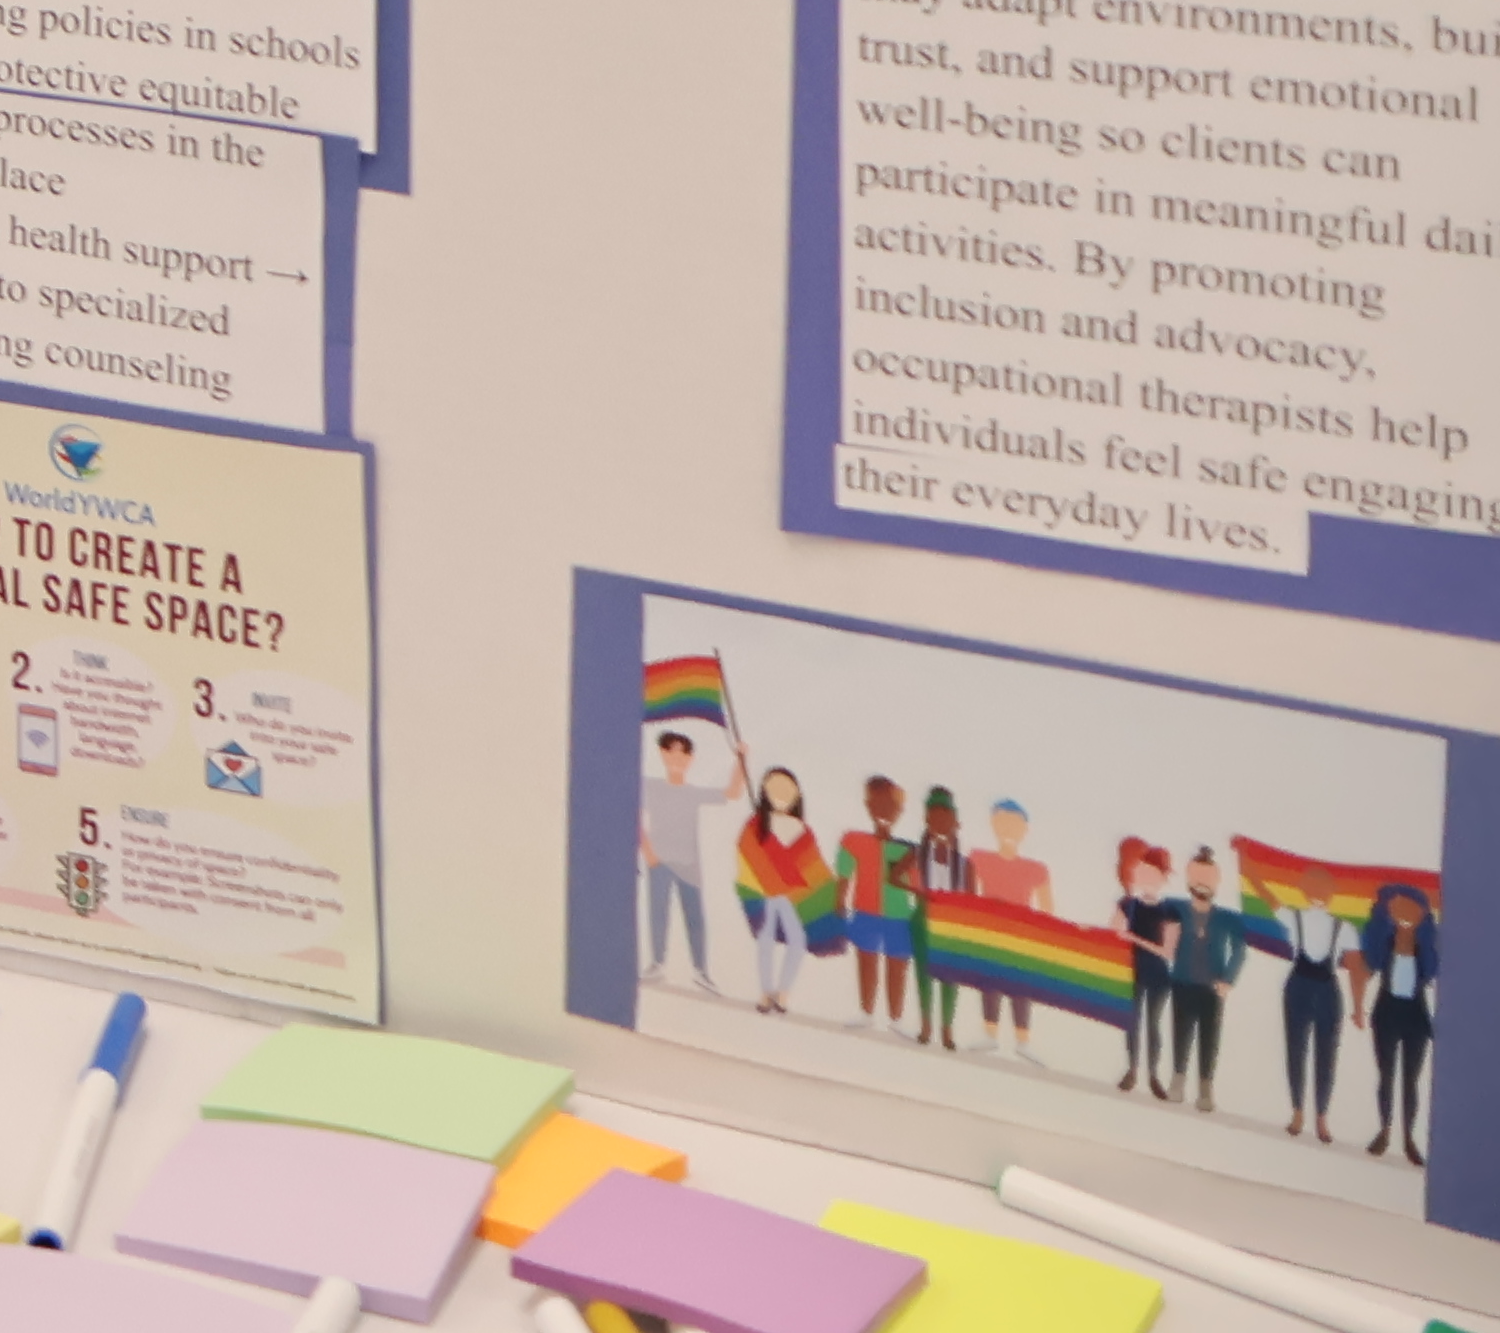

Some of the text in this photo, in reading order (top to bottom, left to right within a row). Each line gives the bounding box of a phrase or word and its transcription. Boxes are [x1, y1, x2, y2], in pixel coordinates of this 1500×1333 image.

[3, 479, 157, 527] WorldYWCA
[12, 516, 56, 563] TO
[67, 526, 207, 590] CREATE
[219, 552, 246, 595] A
[41, 574, 132, 627] SAFE
[142, 591, 287, 653] SPACE?
[11, 650, 44, 695] 2.
[192, 677, 229, 723] 3.
[78, 805, 114, 851] 5.
